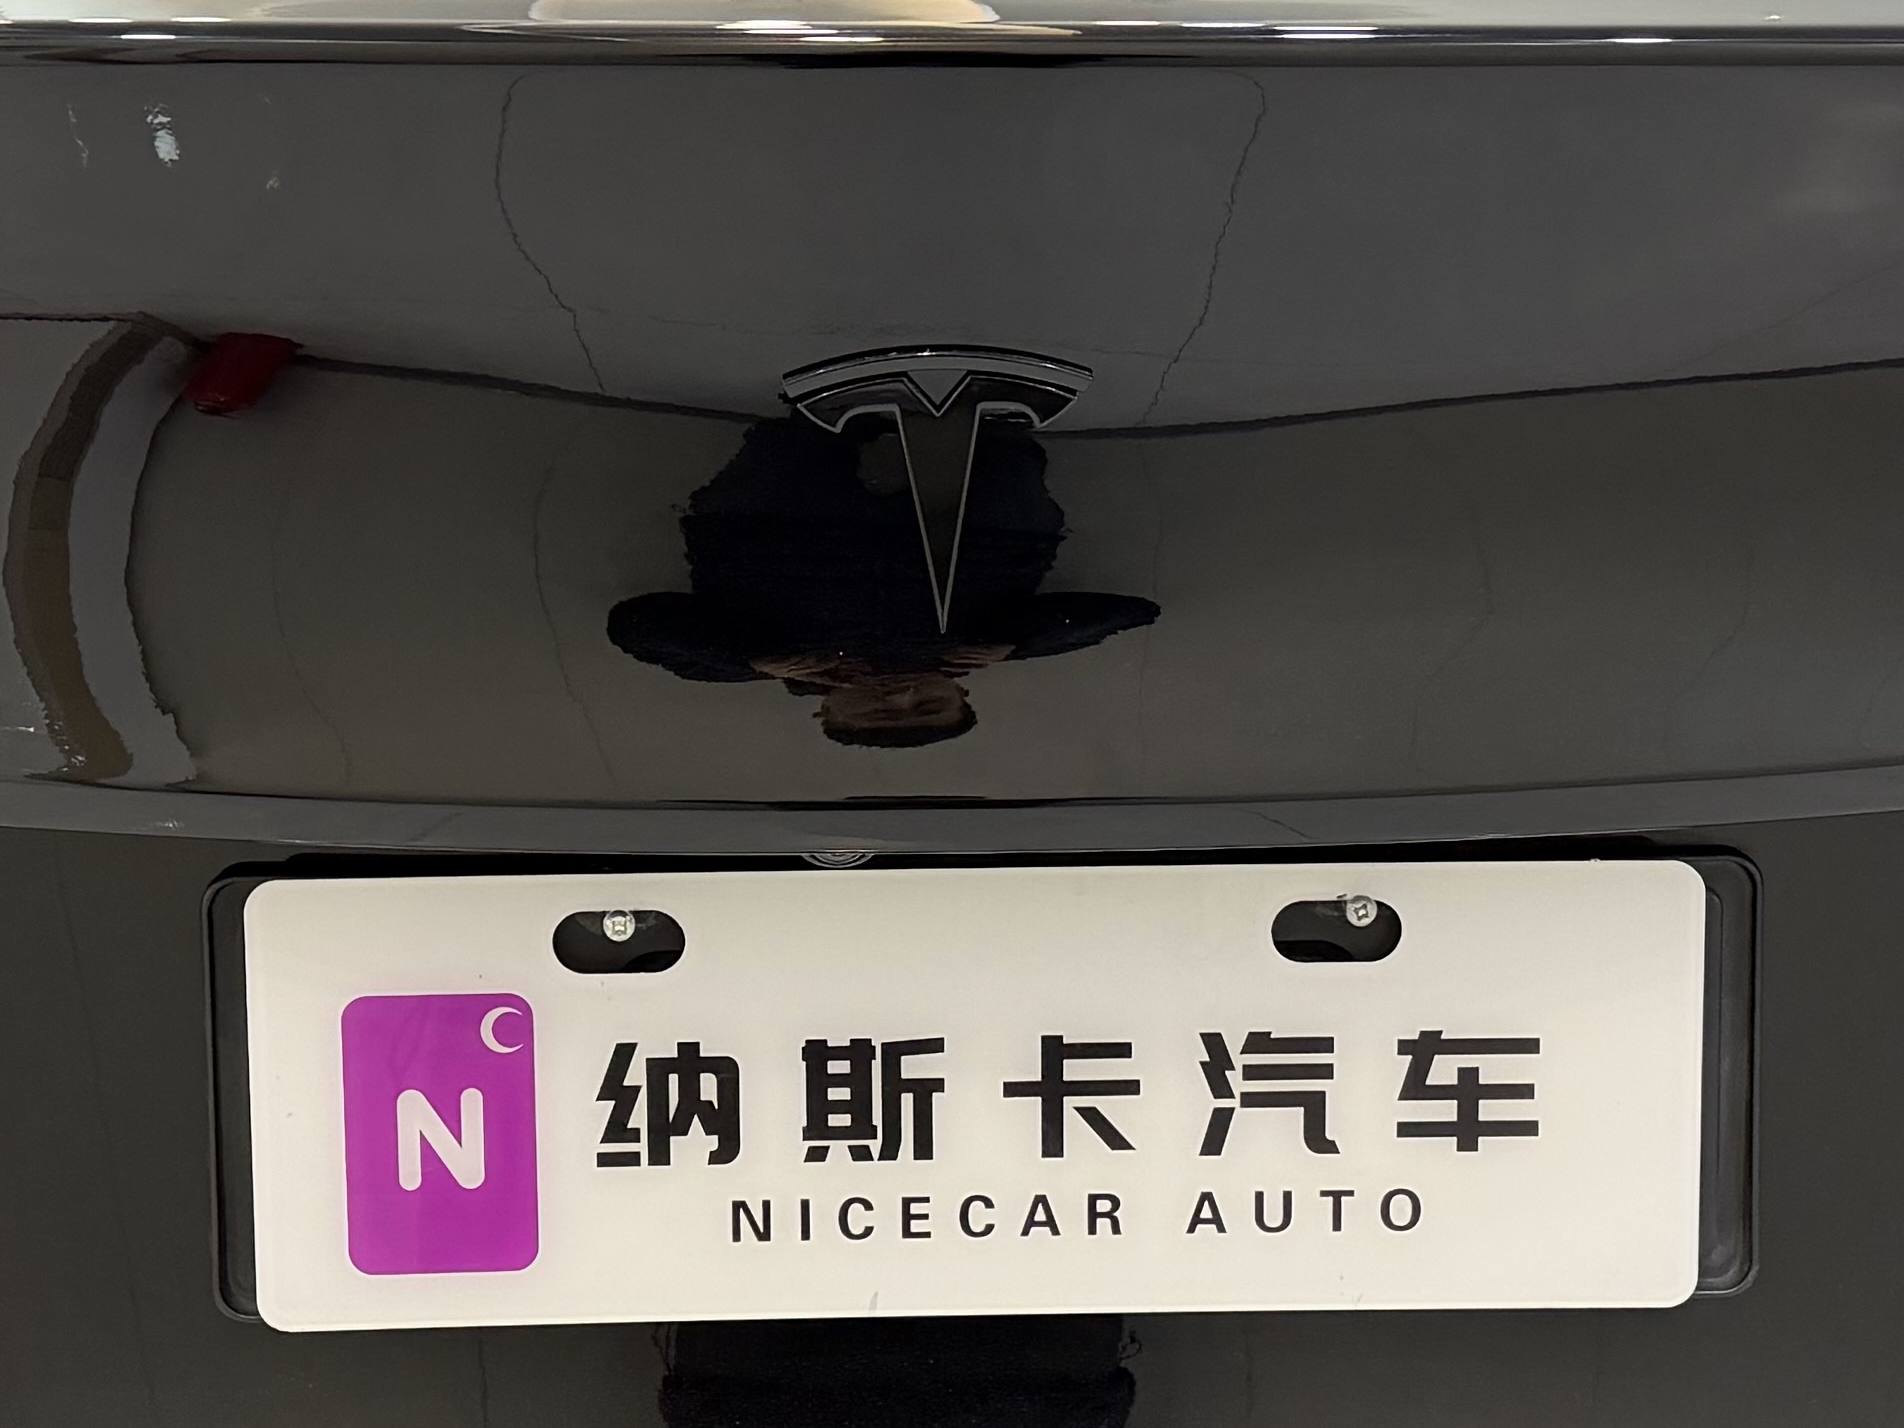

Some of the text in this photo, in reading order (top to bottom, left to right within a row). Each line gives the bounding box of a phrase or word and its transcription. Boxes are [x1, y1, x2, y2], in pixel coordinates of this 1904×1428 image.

[596, 1030, 1542, 1168] 纳斯卡汽车
[730, 1185, 1426, 1243] NICECAR AUTO
